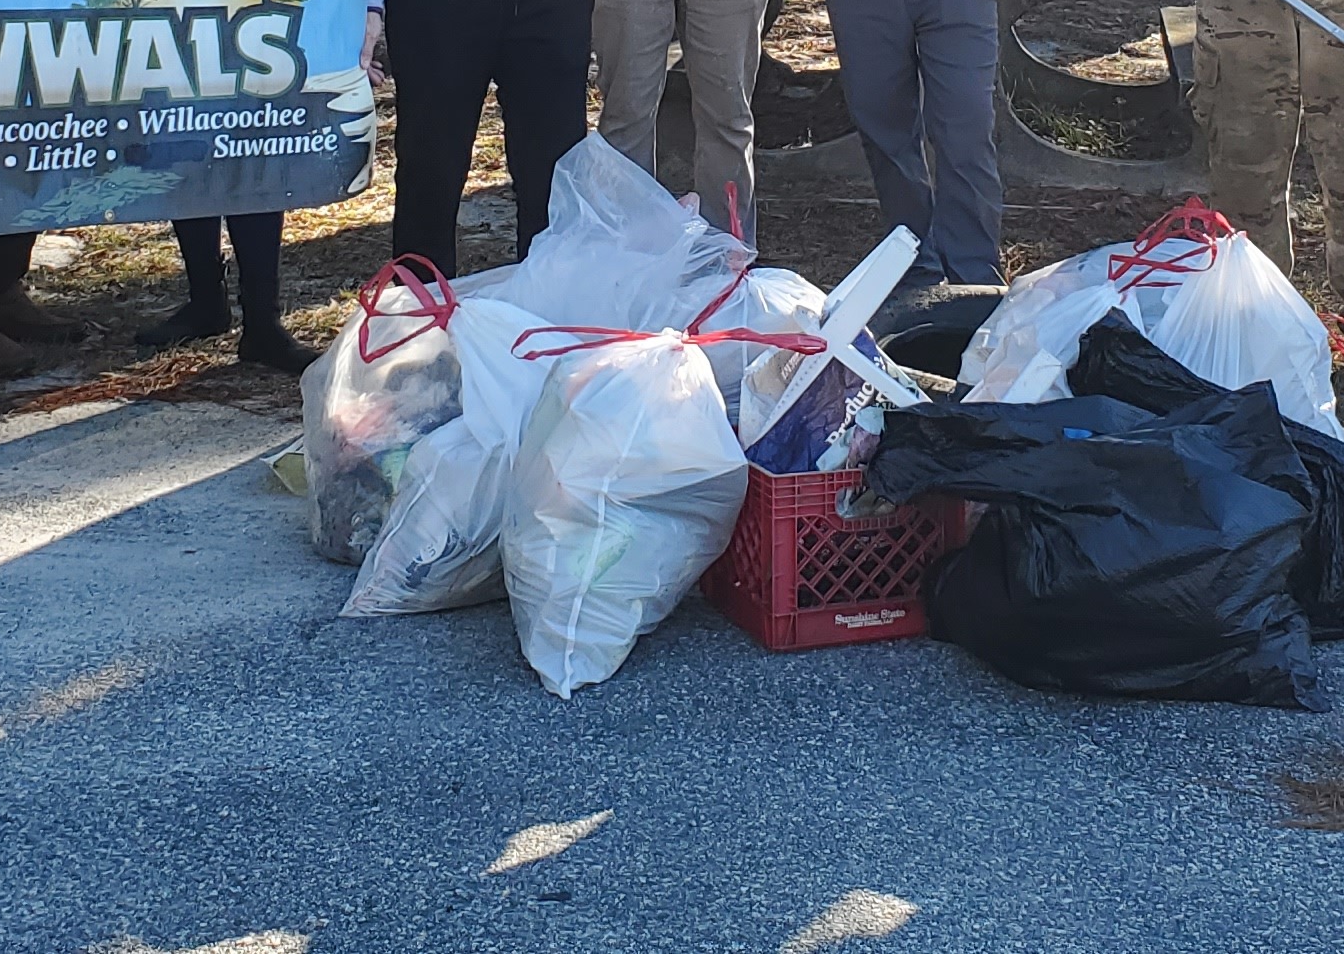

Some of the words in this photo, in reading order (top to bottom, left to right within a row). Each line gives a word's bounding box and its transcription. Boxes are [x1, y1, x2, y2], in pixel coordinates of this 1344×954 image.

[138, 102, 306, 135] Willacoochee
[25, 142, 97, 172] Little
[834, 610, 880, 625] Sunshine
[880, 608, 906, 619] State
